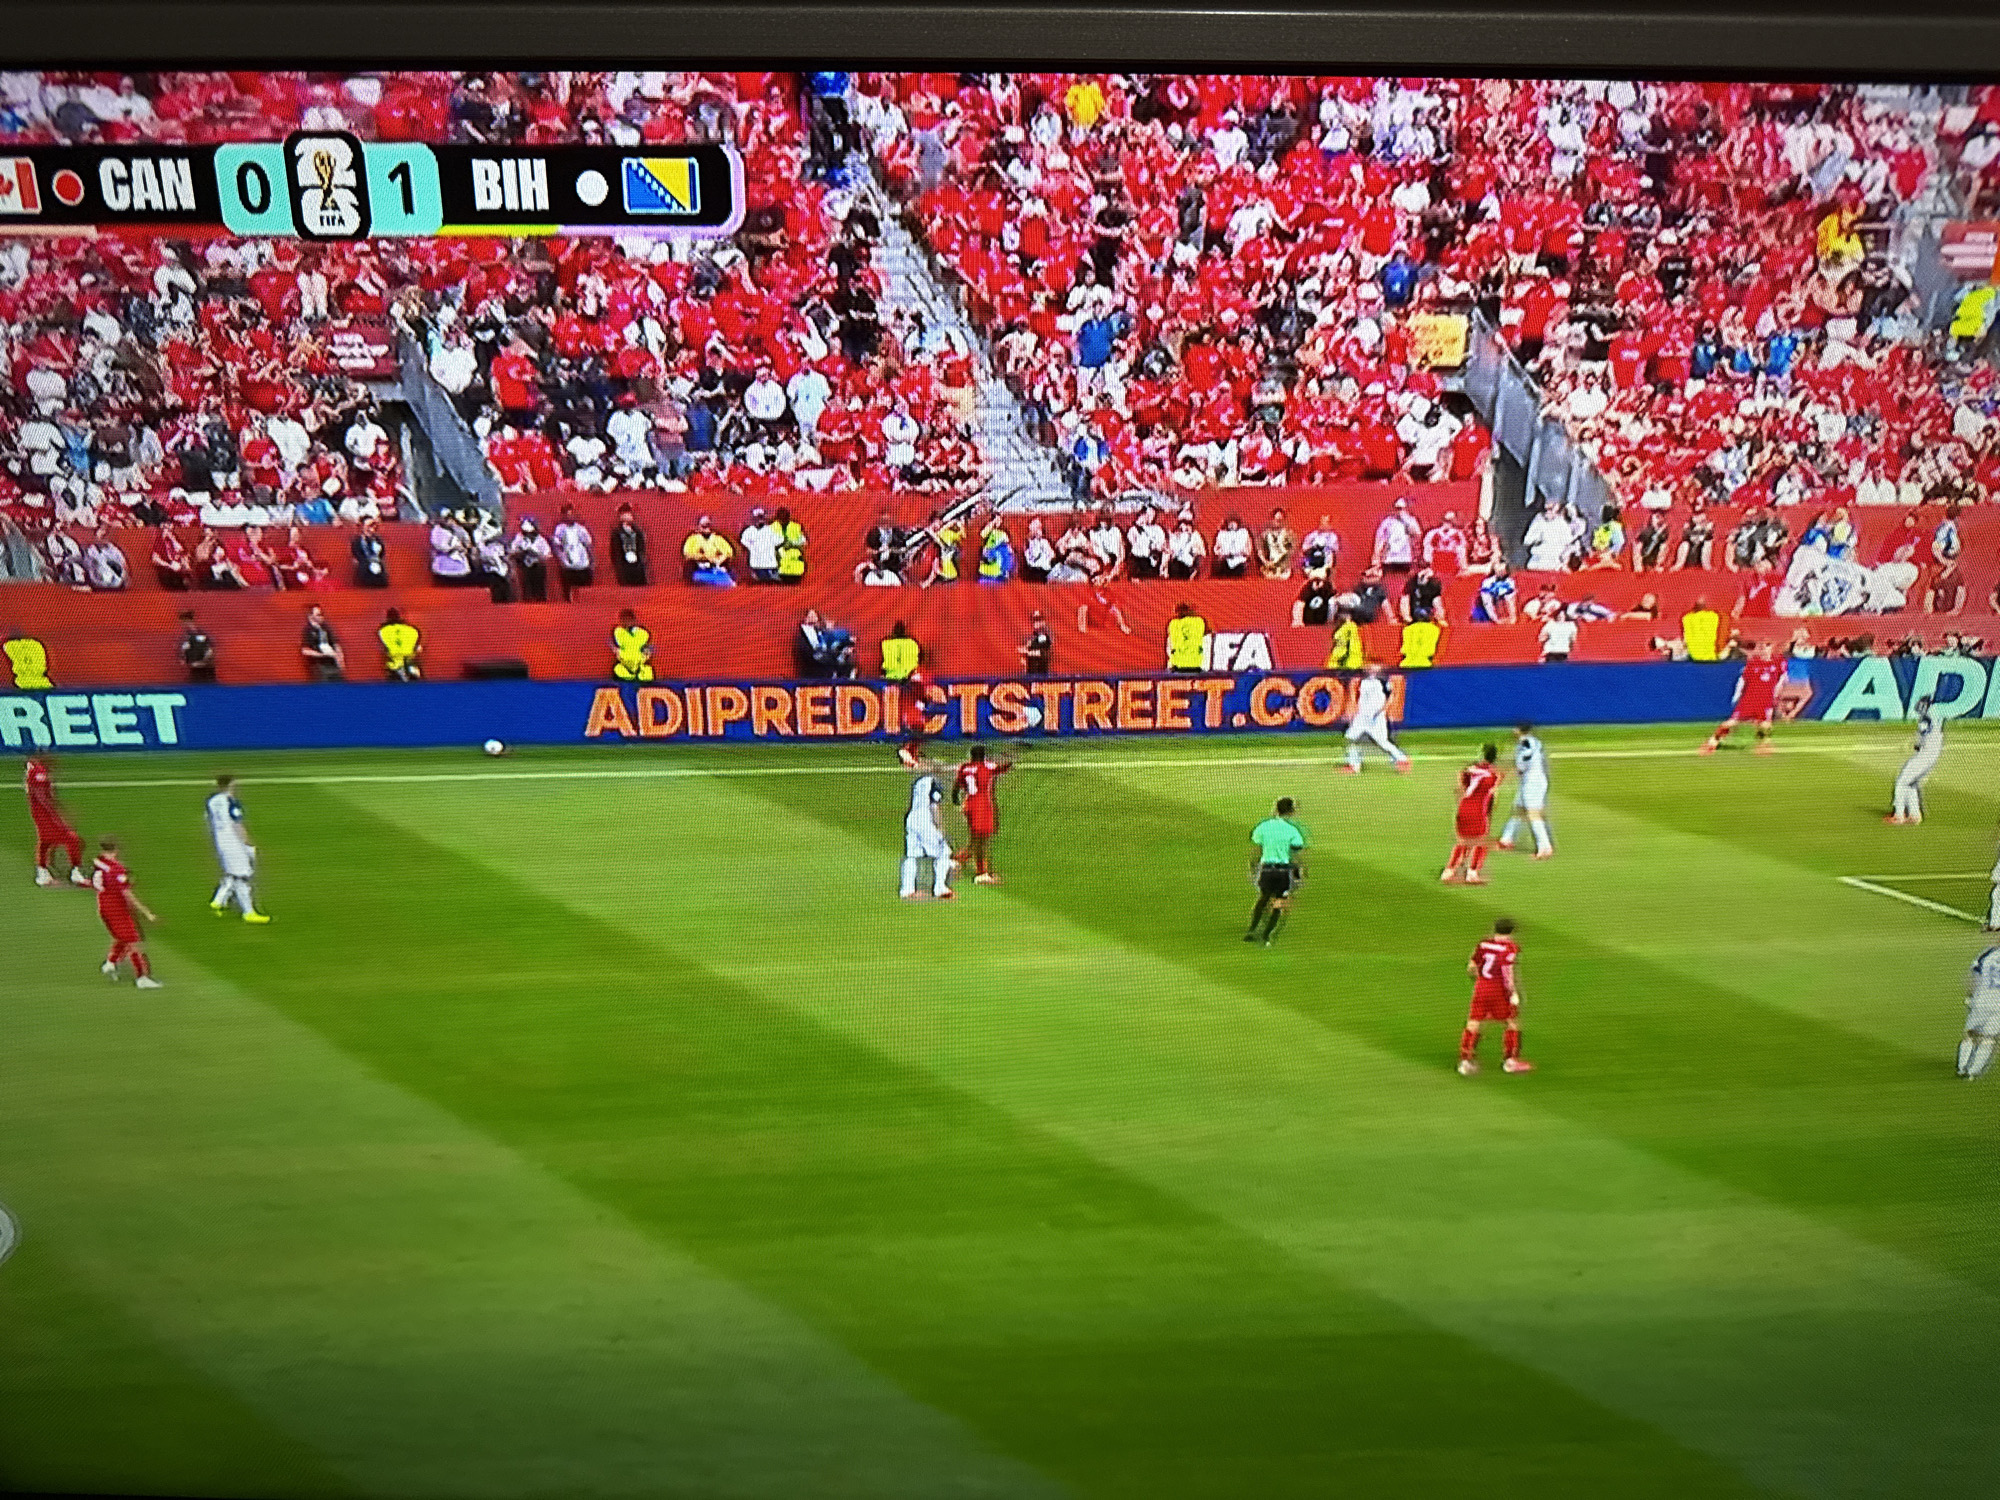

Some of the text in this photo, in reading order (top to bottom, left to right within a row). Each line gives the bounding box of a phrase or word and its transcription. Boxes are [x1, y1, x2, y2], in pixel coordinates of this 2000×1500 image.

[98, 157, 550, 216] CAN 0 1 BIH
[319, 215, 346, 227] FIFA
[1200, 631, 1273, 672] IFA
[0, 693, 187, 747] REET
